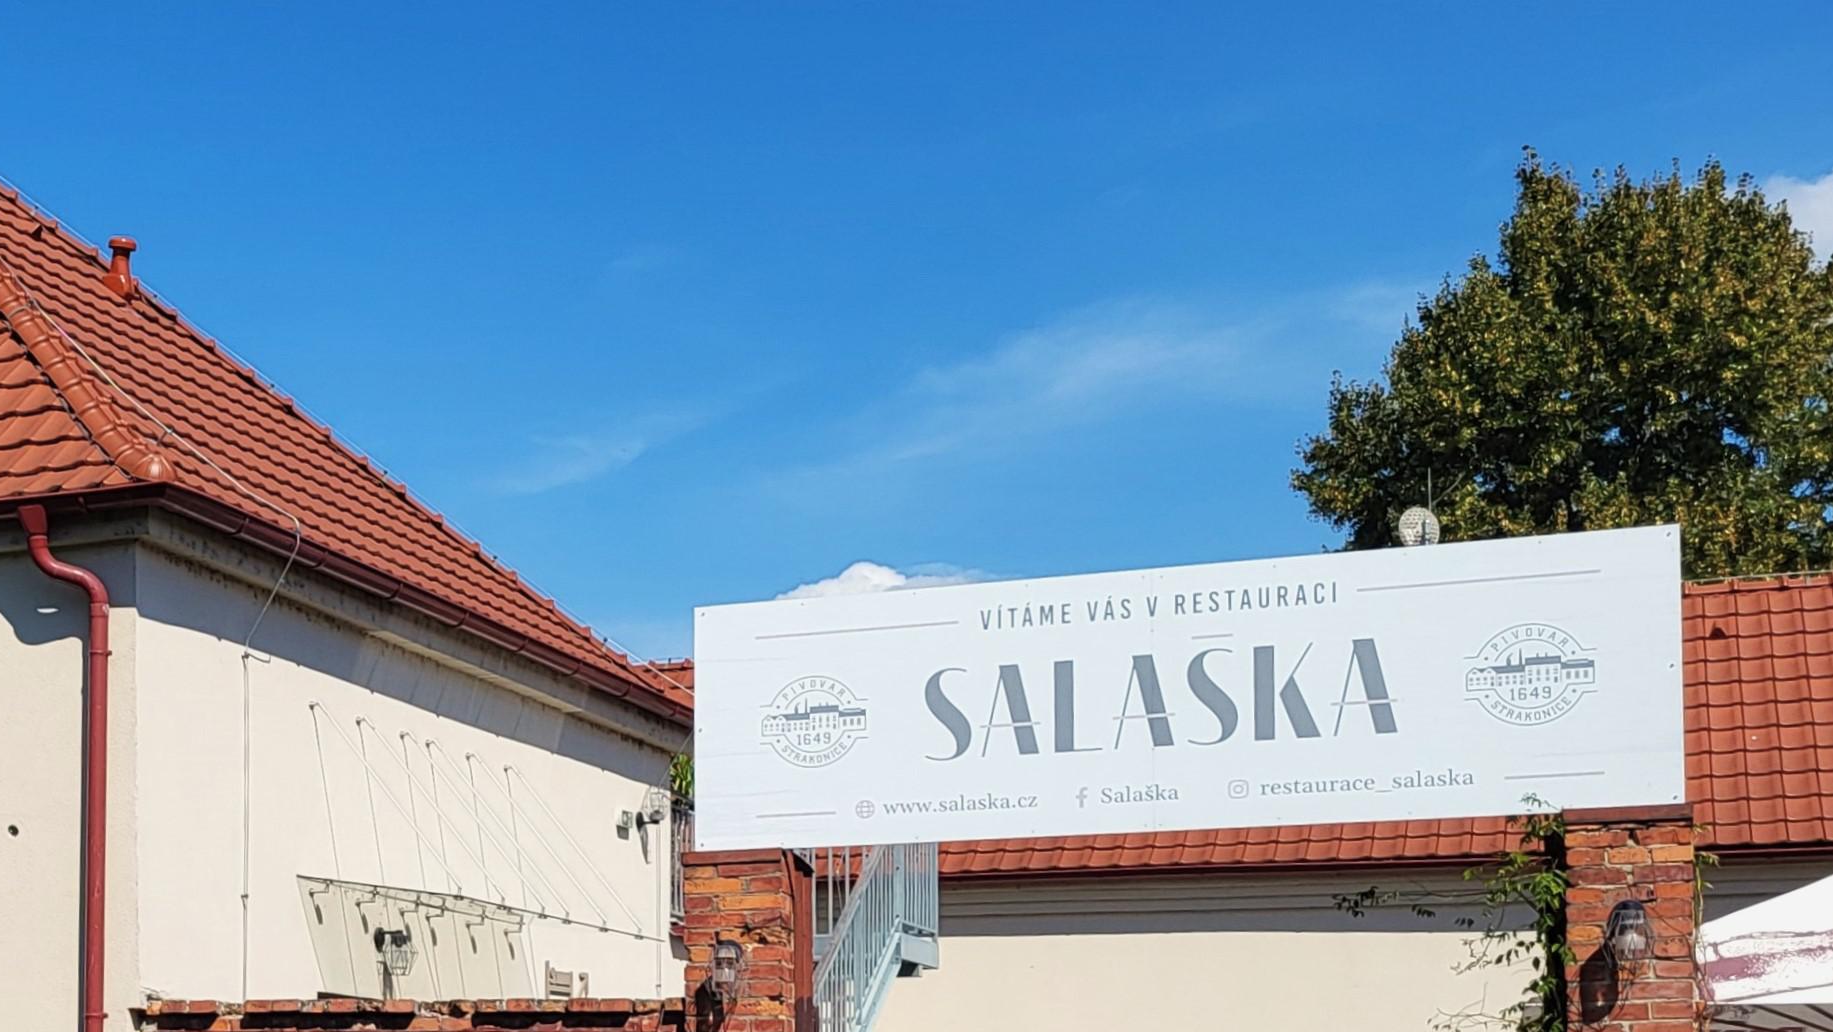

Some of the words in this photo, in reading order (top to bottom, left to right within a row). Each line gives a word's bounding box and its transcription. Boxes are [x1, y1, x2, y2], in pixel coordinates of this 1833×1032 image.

[979, 602, 1073, 631] VÍTÁME
[1086, 595, 1133, 622] VÁS
[1146, 596, 1159, 618] V
[1174, 581, 1338, 615] RESTAURACI
[1490, 627, 1569, 652] PIVOVAR
[782, 679, 846, 701] PIVOVAR
[1509, 686, 1552, 702] 1649
[1490, 696, 1572, 722] STRAKONICE
[797, 731, 832, 746] 1649
[781, 742, 848, 765] STRAKONICE
[882, 793, 1038, 815] www.salaska.cz
[1100, 784, 1179, 804] Salaška
[1260, 768, 1474, 796] restaurace_salaska
